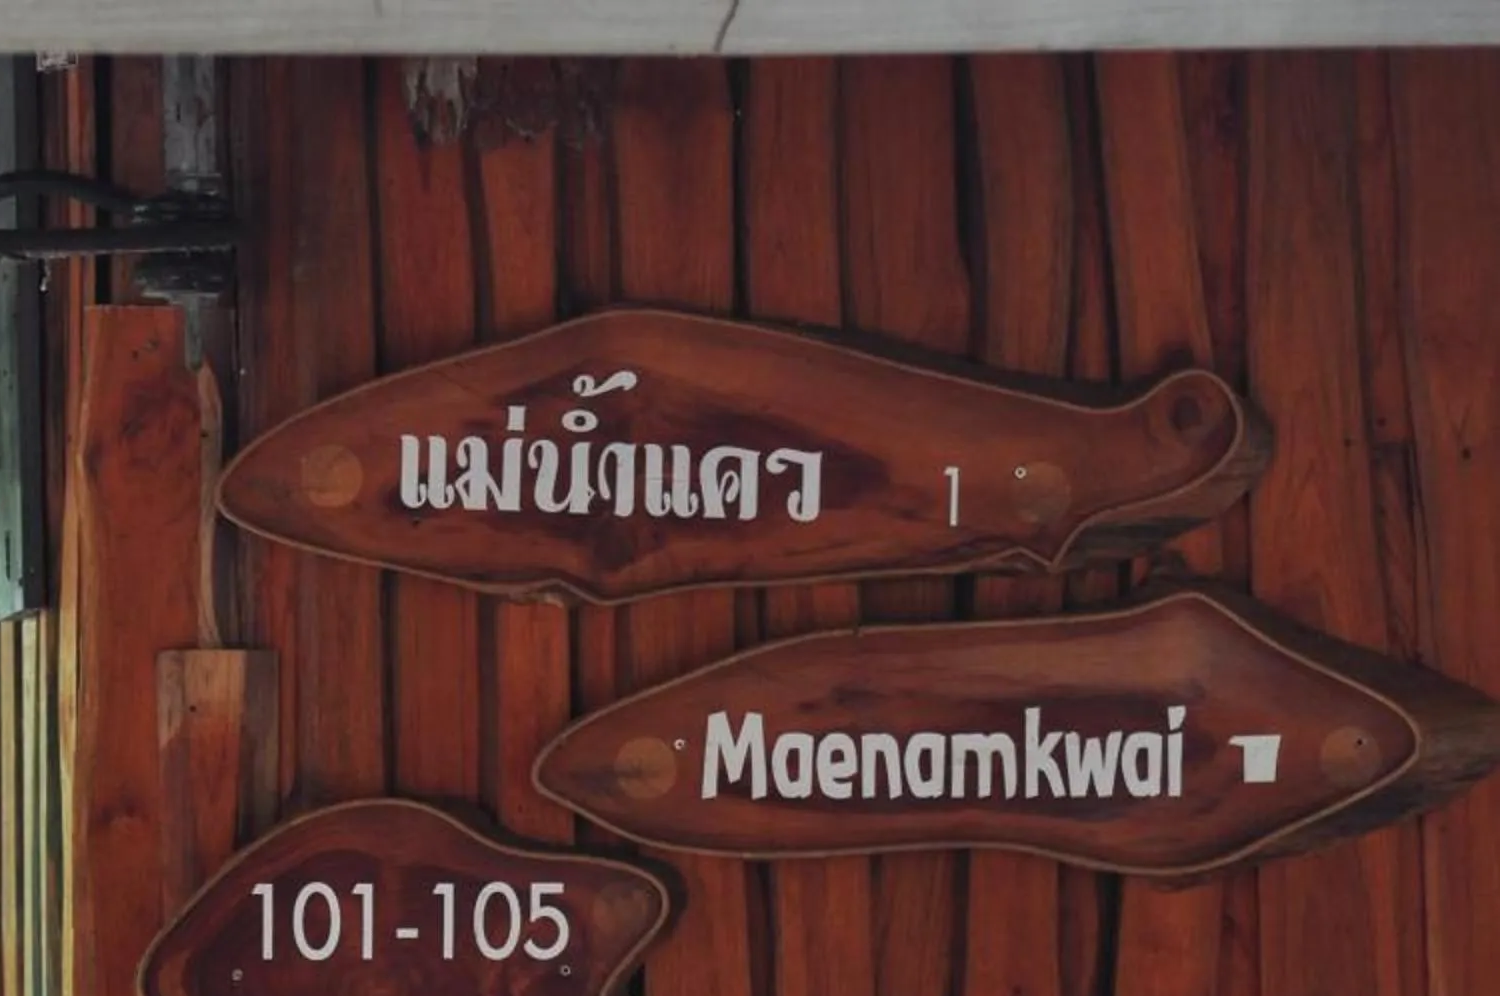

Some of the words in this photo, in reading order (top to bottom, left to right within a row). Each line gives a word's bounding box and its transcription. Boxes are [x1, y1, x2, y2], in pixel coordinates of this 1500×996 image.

[399, 370, 823, 523] แม่น้ำแคว
[943, 465, 960, 527] 1
[700, 704, 1187, 800] Maenamkwai
[1227, 733, 1283, 784] 1
[251, 880, 570, 962] 101-105
